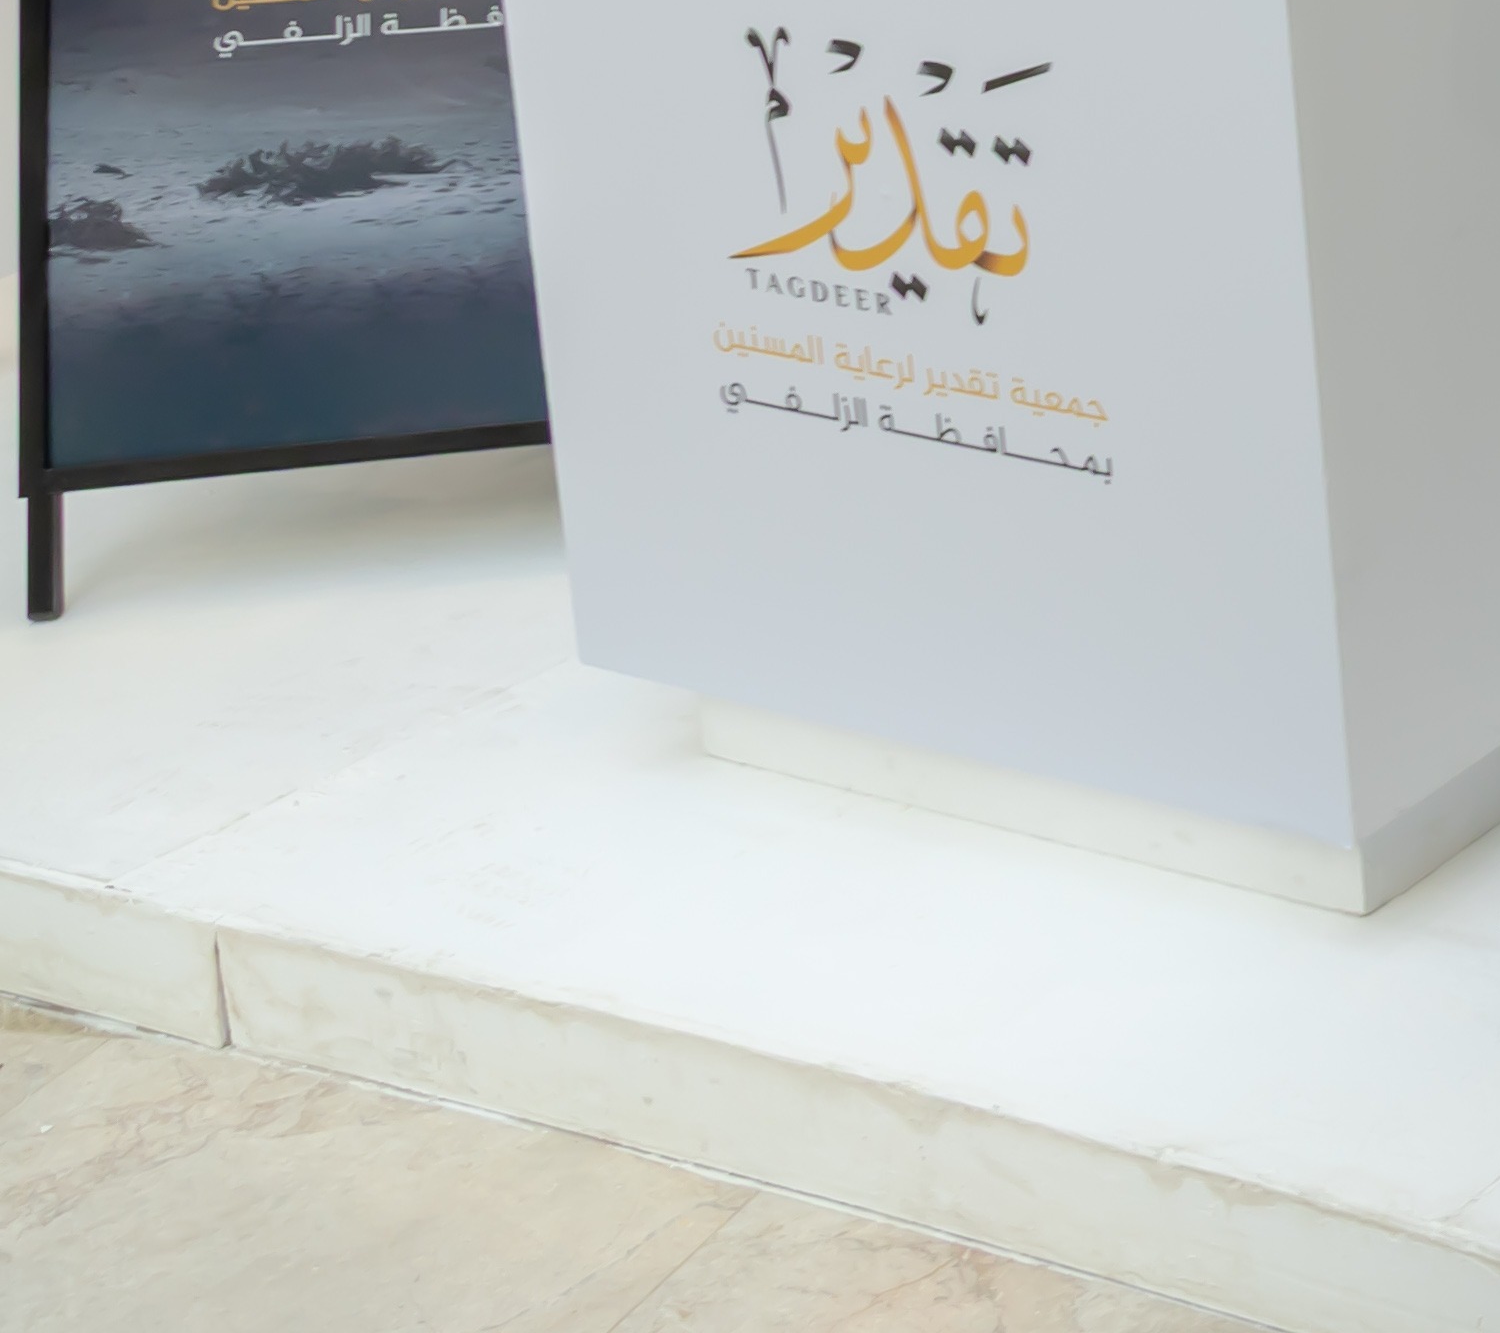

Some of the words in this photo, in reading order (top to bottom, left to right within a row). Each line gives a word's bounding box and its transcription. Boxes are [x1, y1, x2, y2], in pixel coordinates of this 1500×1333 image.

[213, 12, 371, 58] الزلفي
[744, 268, 893, 316] TAGDEER
[713, 321, 825, 365] المسنين
[834, 341, 915, 390] لرعاية
[719, 381, 868, 432] الزلفي
[923, 367, 999, 400] تقدير
[1009, 374, 1109, 427] جمعية
[877, 405, 1113, 485] بمحافظة
